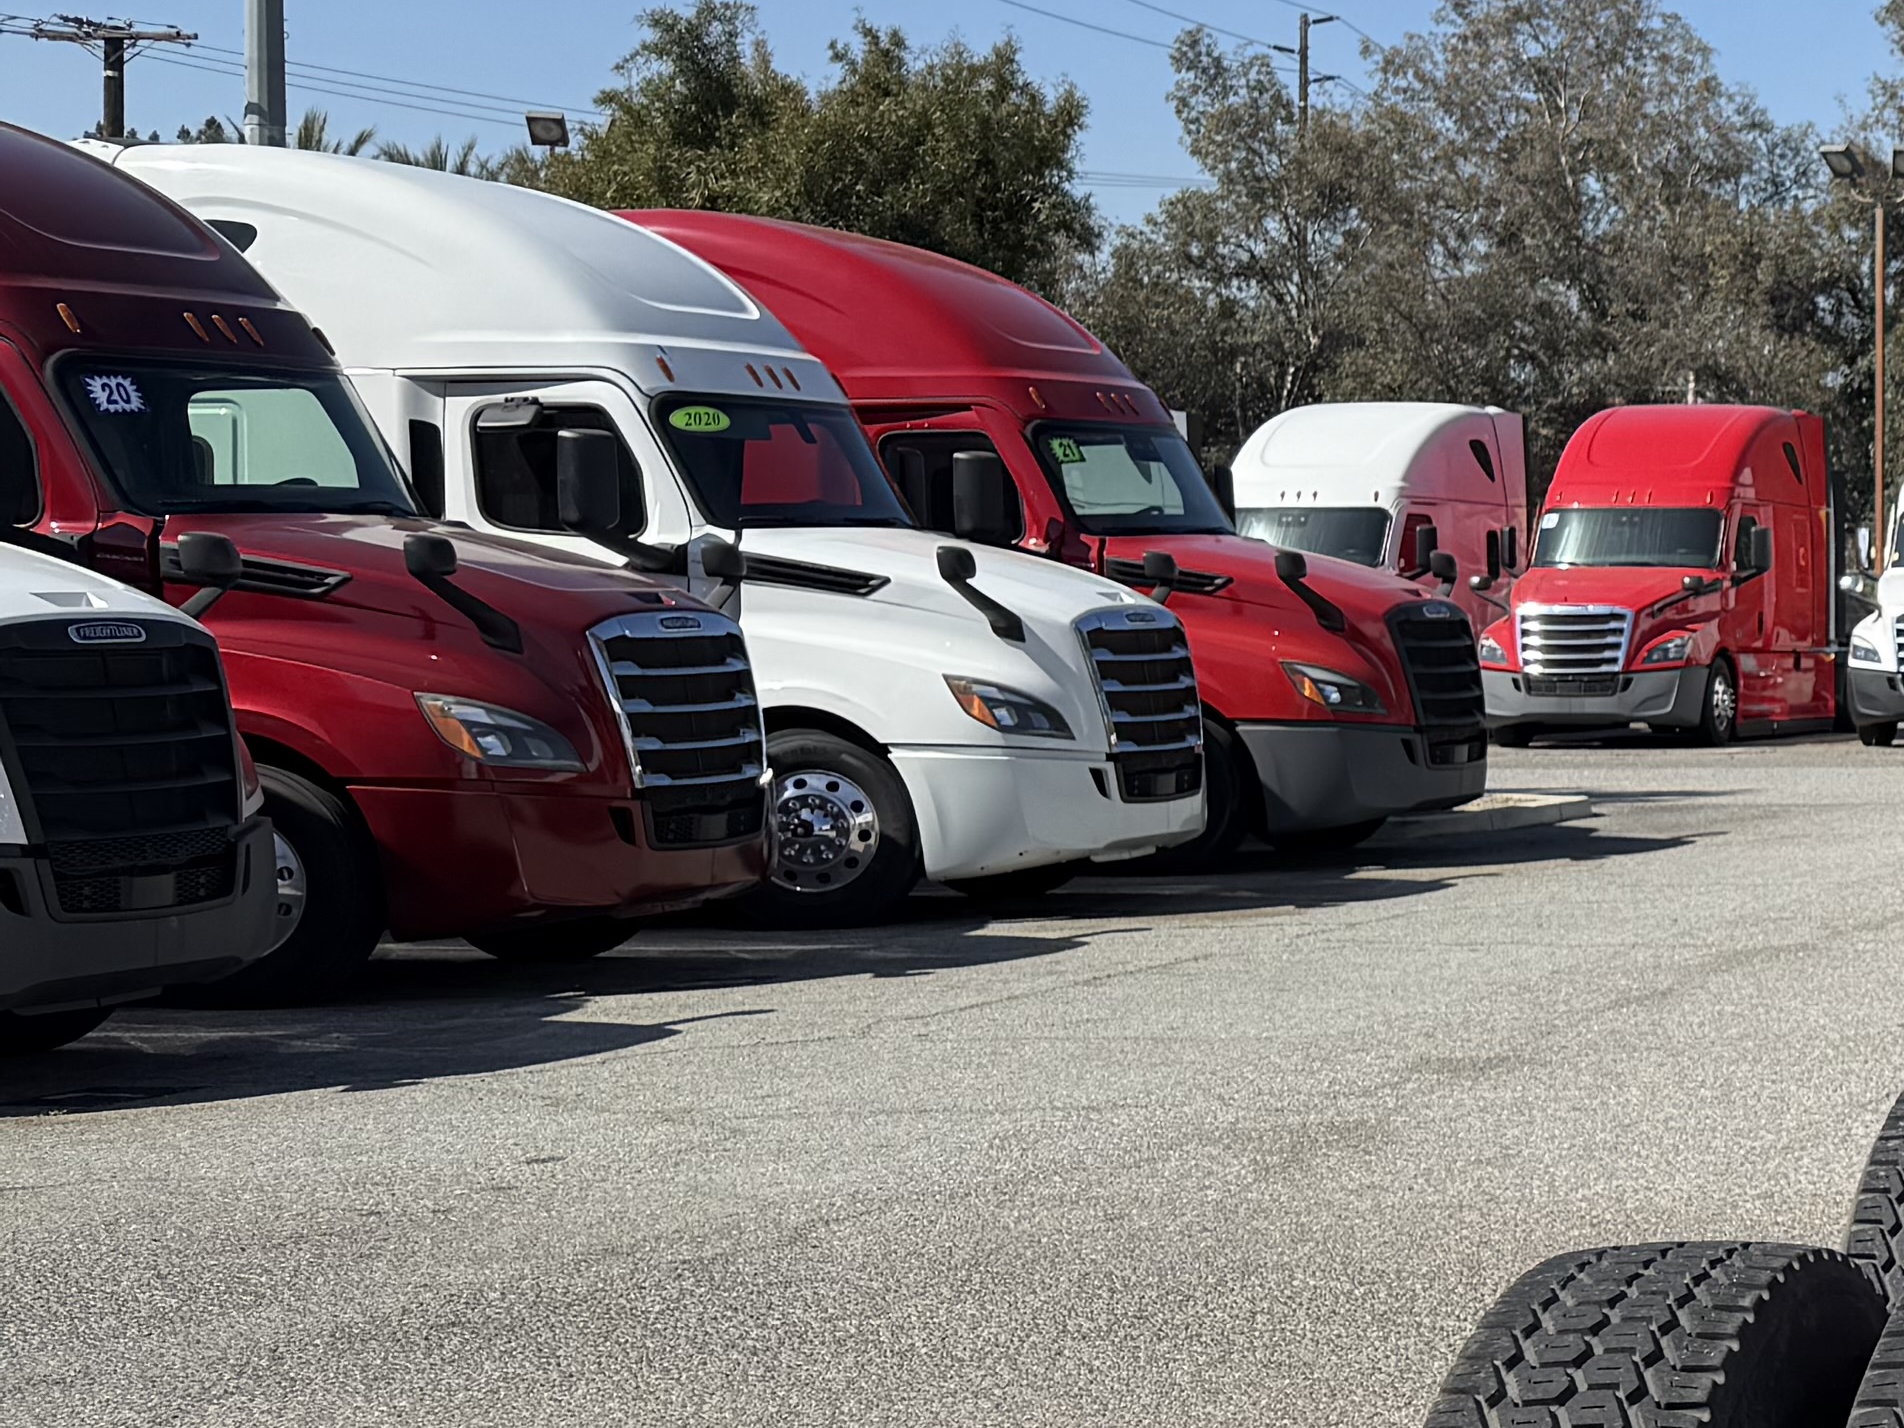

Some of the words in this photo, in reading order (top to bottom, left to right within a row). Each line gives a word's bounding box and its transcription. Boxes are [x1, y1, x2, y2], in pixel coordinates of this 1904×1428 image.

[101, 382, 132, 405] 20
[684, 411, 721, 427] 2020
[1059, 441, 1076, 458] 21
